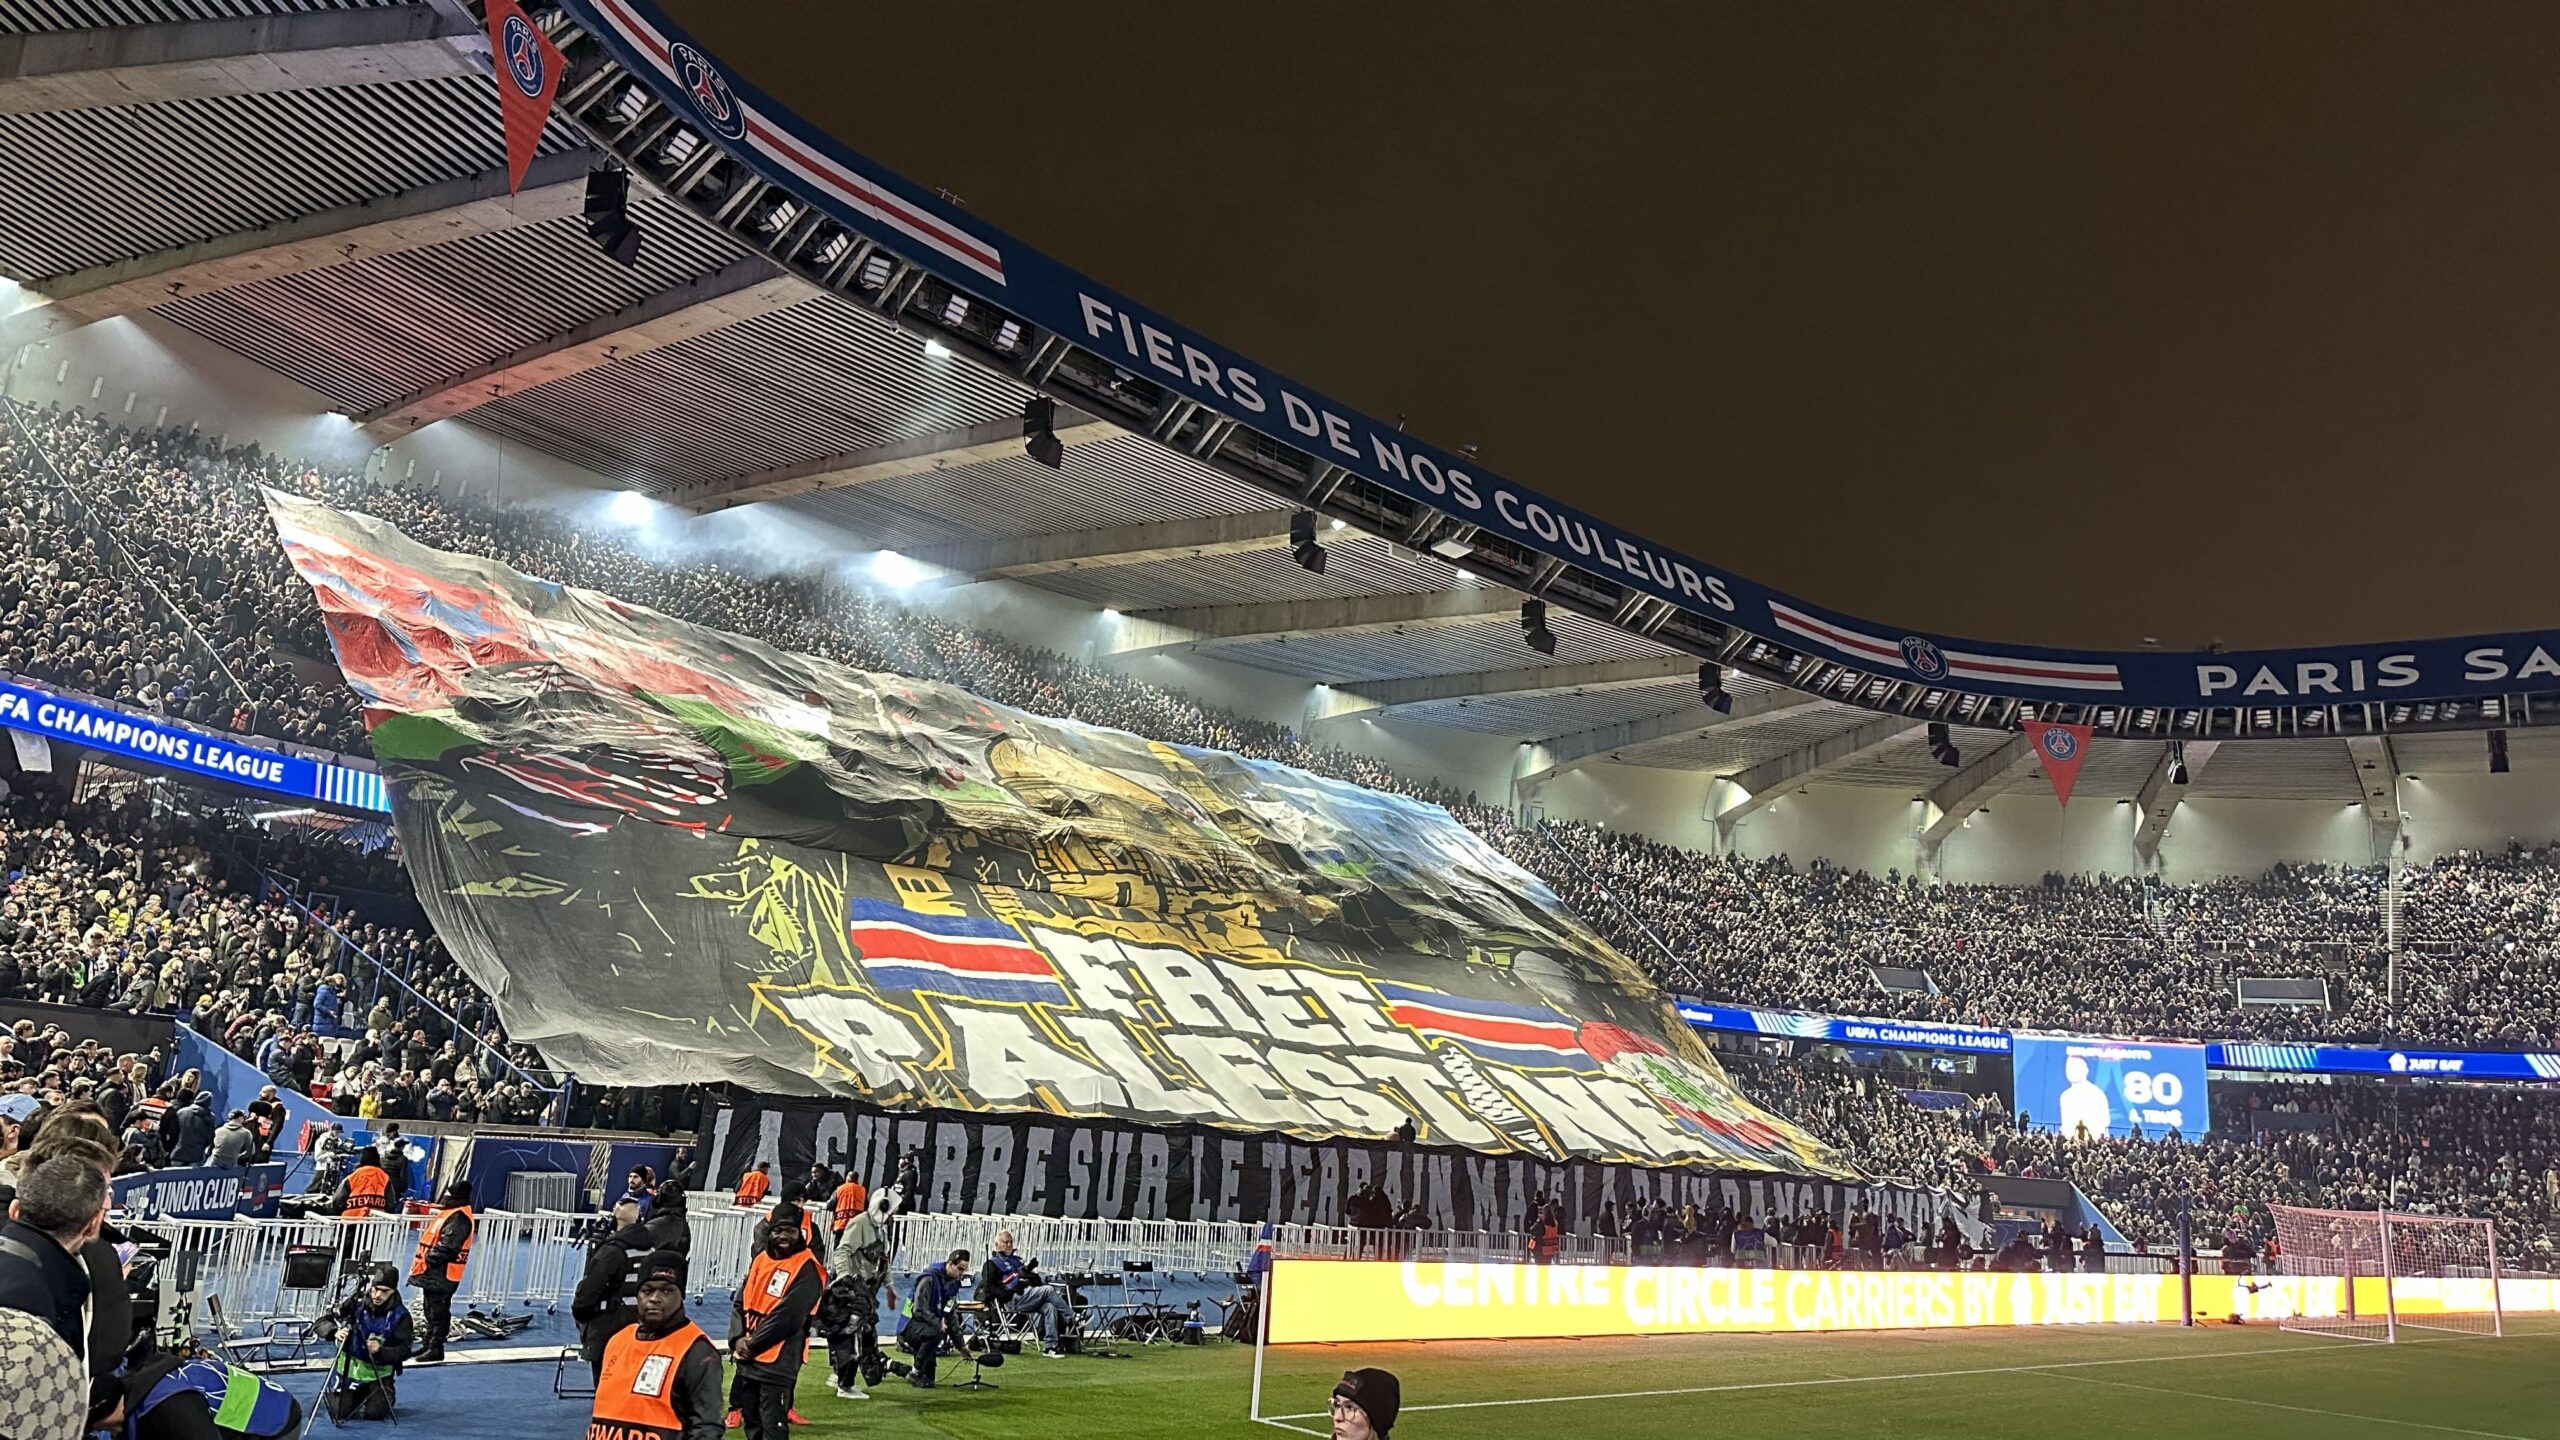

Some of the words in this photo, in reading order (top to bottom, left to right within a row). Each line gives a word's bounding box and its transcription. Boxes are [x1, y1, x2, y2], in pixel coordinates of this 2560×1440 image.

[511, 20, 537, 54] PARIS
[678, 46, 726, 91] PARIS
[1078, 292, 1266, 413] FIERS
[1280, 390, 1360, 459] DE
[1369, 432, 1482, 510] NOS
[1494, 490, 1735, 612] COULEURS
[2196, 654, 2420, 697] PARIS
[2464, 645, 2560, 681] SA
[38, 703, 189, 760] CHAMPIONS
[193, 743, 284, 783] LEAGUE
[1030, 926, 1426, 1055] FREE
[1846, 1026, 1878, 1040] UEFA
[1880, 1028, 1957, 1046] CHAMPIONS
[1959, 1033, 2009, 1049] LEAGUE
[778, 993, 1724, 1163] PALESTINE
[2124, 1071, 2182, 1105] 80
[704, 1108, 783, 1196] LA
[812, 1111, 1056, 1215] GUERRE
[1063, 1128, 1170, 1220] SUR
[1190, 1134, 1245, 1222] LE
[150, 1179, 204, 1216] JUNIOR
[202, 1177, 239, 1211] CLUB
[1623, 1266, 1776, 1326] CIRCLE
[1784, 1271, 1956, 1330] CARRIERS
[1962, 1273, 1999, 1326] BY
[2040, 1273, 2111, 1325] JUST
[2112, 1274, 2163, 1323] EAT
